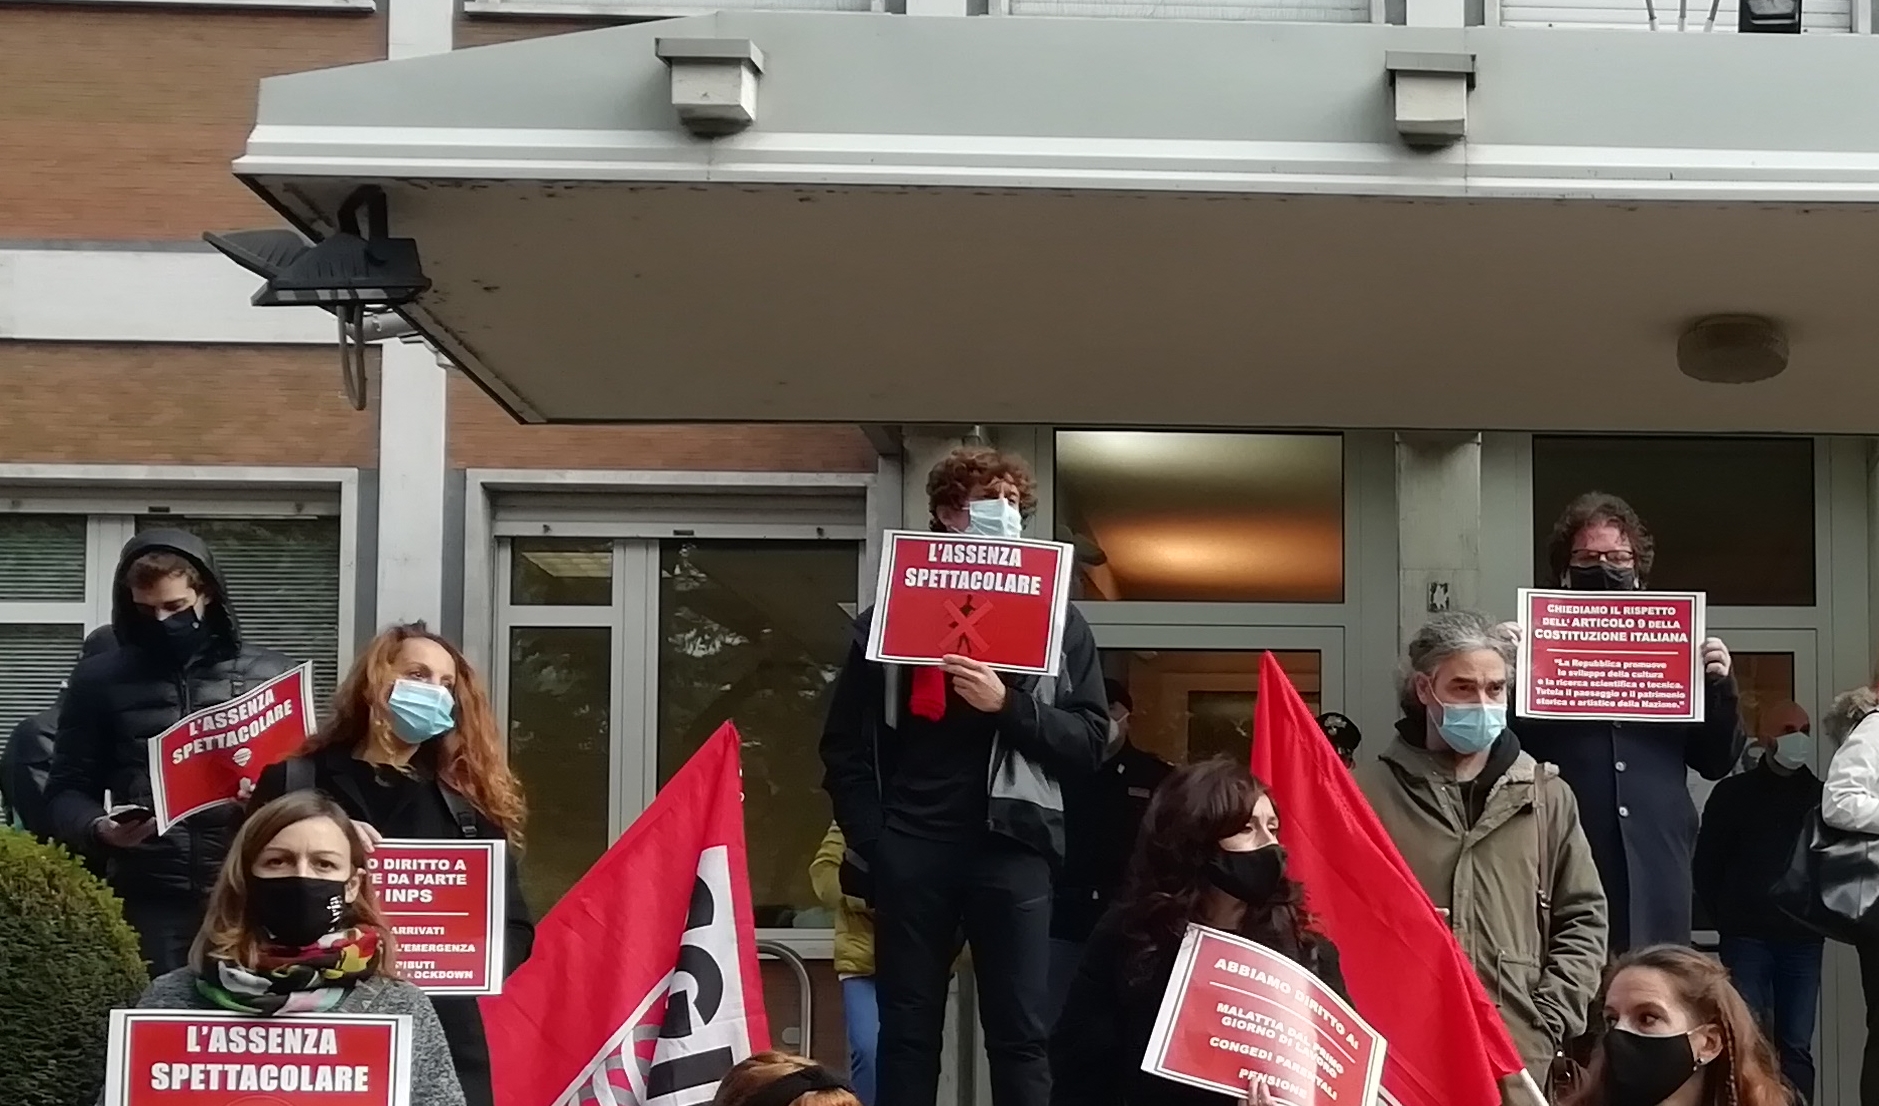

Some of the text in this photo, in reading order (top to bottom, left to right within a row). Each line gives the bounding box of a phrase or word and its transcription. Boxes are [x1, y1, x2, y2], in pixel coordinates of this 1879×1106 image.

[928, 543, 1022, 568] L'ASSENZA
[904, 568, 1042, 596] SPETTACOLARE
[1547, 604, 1676, 616] CHIEDIAMO IL RISPETTO
[1542, 617, 1681, 629] DELL' ARTICOLO 9 DELLA
[1534, 629, 1688, 643] COSTITUZIONE ITALIANA
[1571, 659, 1621, 669] Repubblica
[1623, 661, 1667, 670] promuove
[1568, 669, 1606, 679] sviluppo
[1607, 670, 1630, 678] della
[1631, 671, 1664, 679] cultura
[1545, 678, 1555, 686] la
[1556, 678, 1588, 687] ricerca
[1590, 679, 1637, 688] scientifica
[1535, 686, 1564, 696] Tutela
[1565, 688, 1572, 696] il
[1629, 690, 1636, 698] il
[1637, 691, 1686, 700] patrimonio
[1617, 699, 1640, 708] della
[189, 688, 275, 736] L'ASSENZA
[172, 699, 292, 765] SPETTACOLARE
[384, 858, 450, 871] DIRITTO
[454, 858, 467, 871] A
[387, 873, 410, 885] DA
[414, 873, 467, 886] PARTE
[385, 888, 433, 902] INPS
[391, 926, 445, 935] ARRIVATI
[407, 970, 474, 979] OCKDOWN
[1214, 958, 1291, 994] ABBIAMO
[1294, 990, 1346, 1035] DIRITTO
[186, 1025, 338, 1055] L'ASSENZA
[1216, 1002, 1344, 1074] MALATTIA DAL PRIMO
[1221, 1016, 1337, 1079] GIORNO DI LAVORO
[1209, 1036, 1338, 1101] CONGEDI PARENTALI
[150, 1062, 369, 1092] SPETTACOLARE
